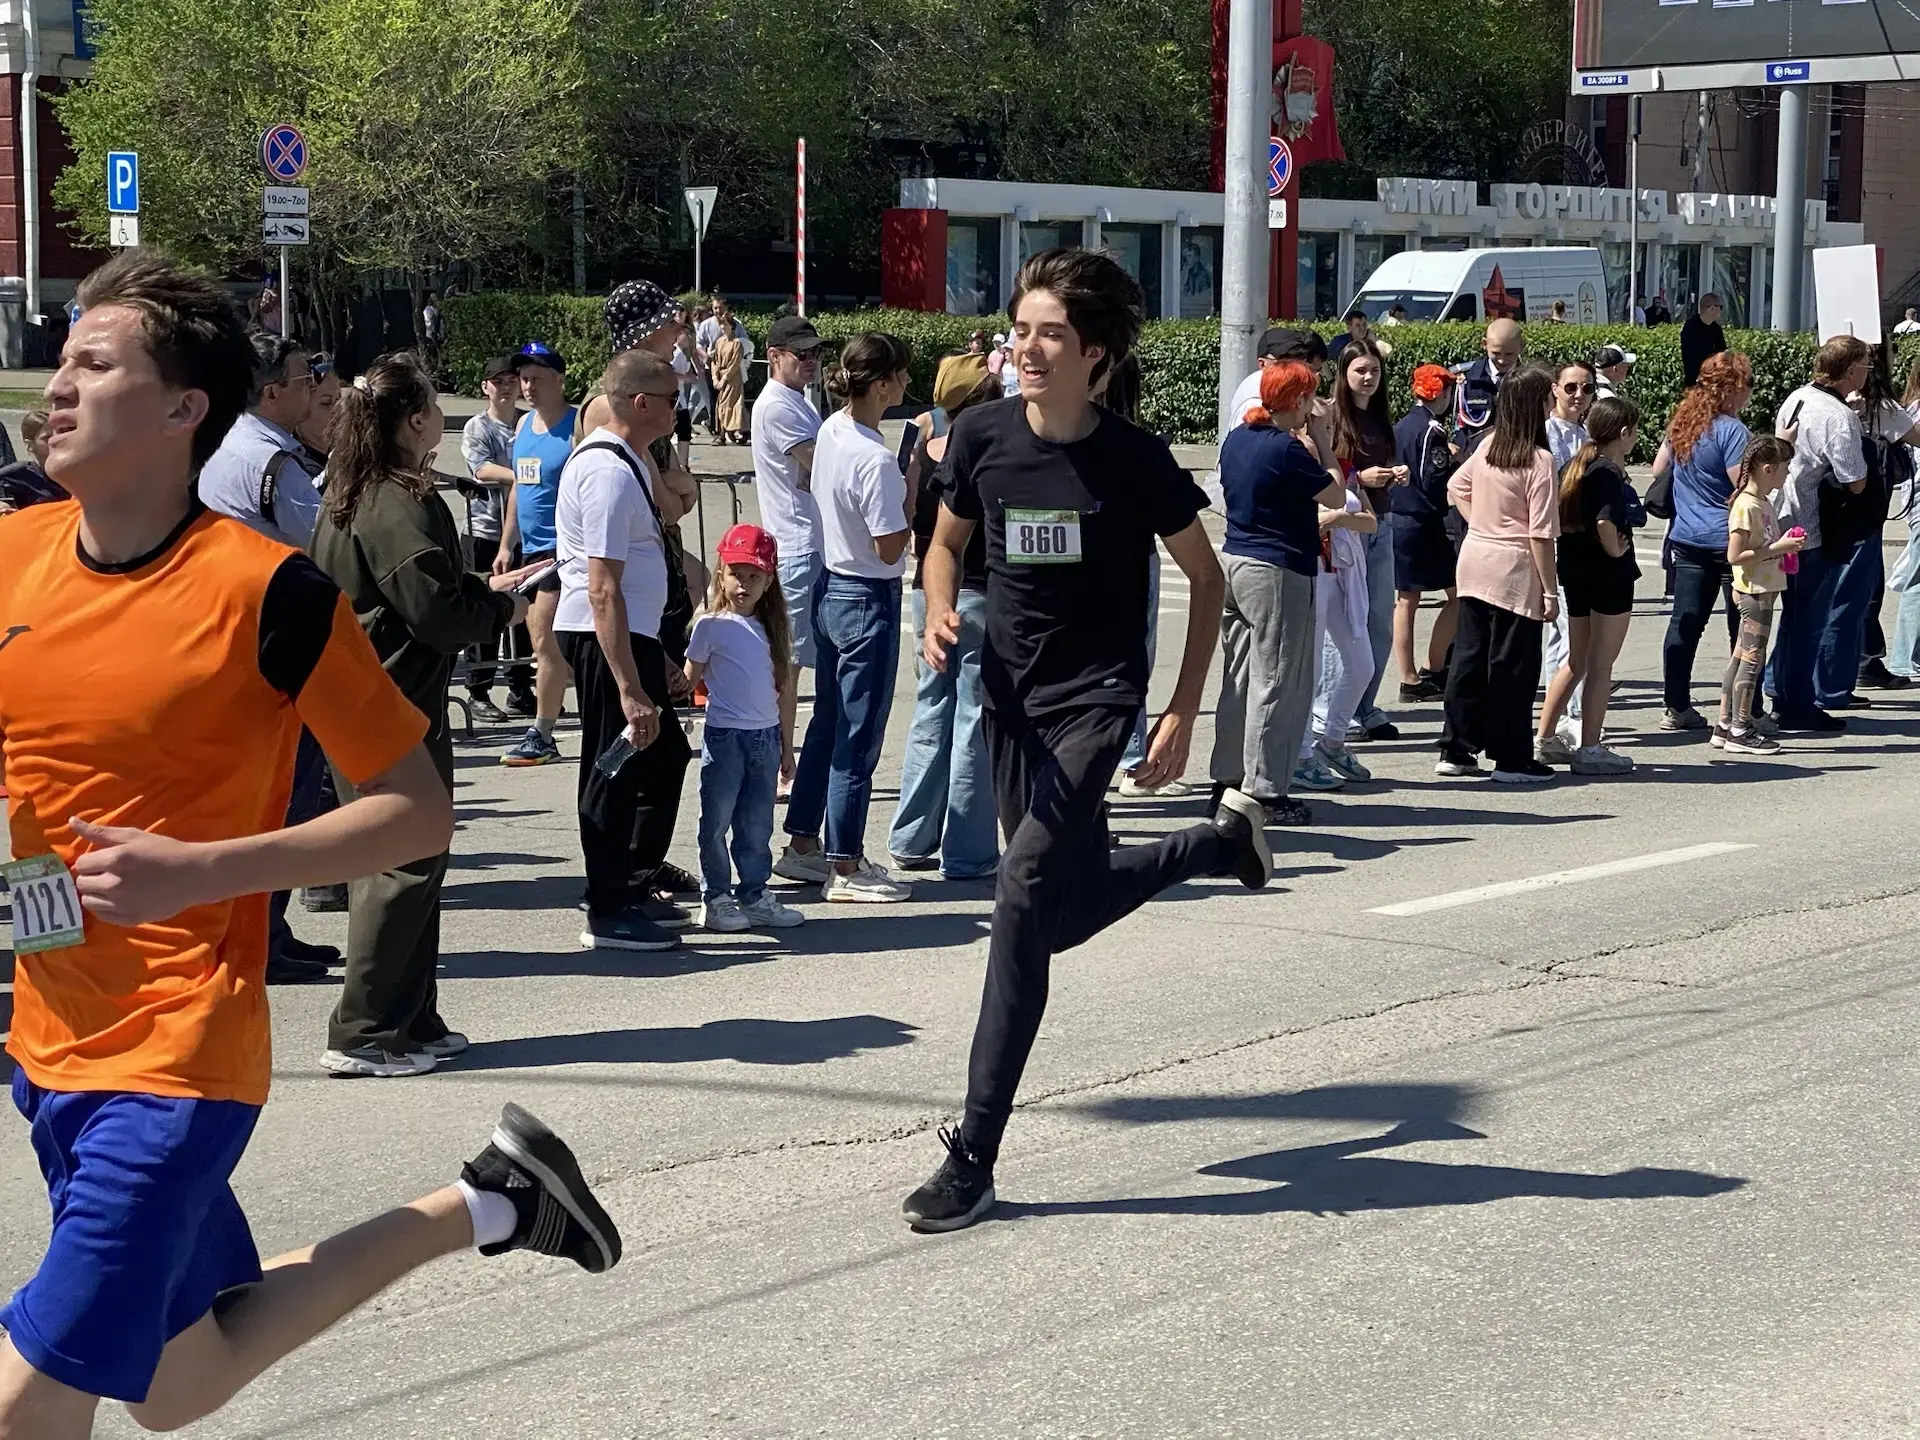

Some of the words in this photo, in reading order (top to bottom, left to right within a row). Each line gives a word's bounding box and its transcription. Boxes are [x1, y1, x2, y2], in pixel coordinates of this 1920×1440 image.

[1784, 67, 1802, 76] Russ
[115, 159, 133, 205] P
[1392, 177, 1478, 216] ИМИ
[1692, 191, 1827, 232] БАРНЛ
[520, 465, 536, 479] 145
[262, 474, 273, 505] Canon
[1020, 525, 1067, 554] 860
[14, 877, 76, 936] 1121
